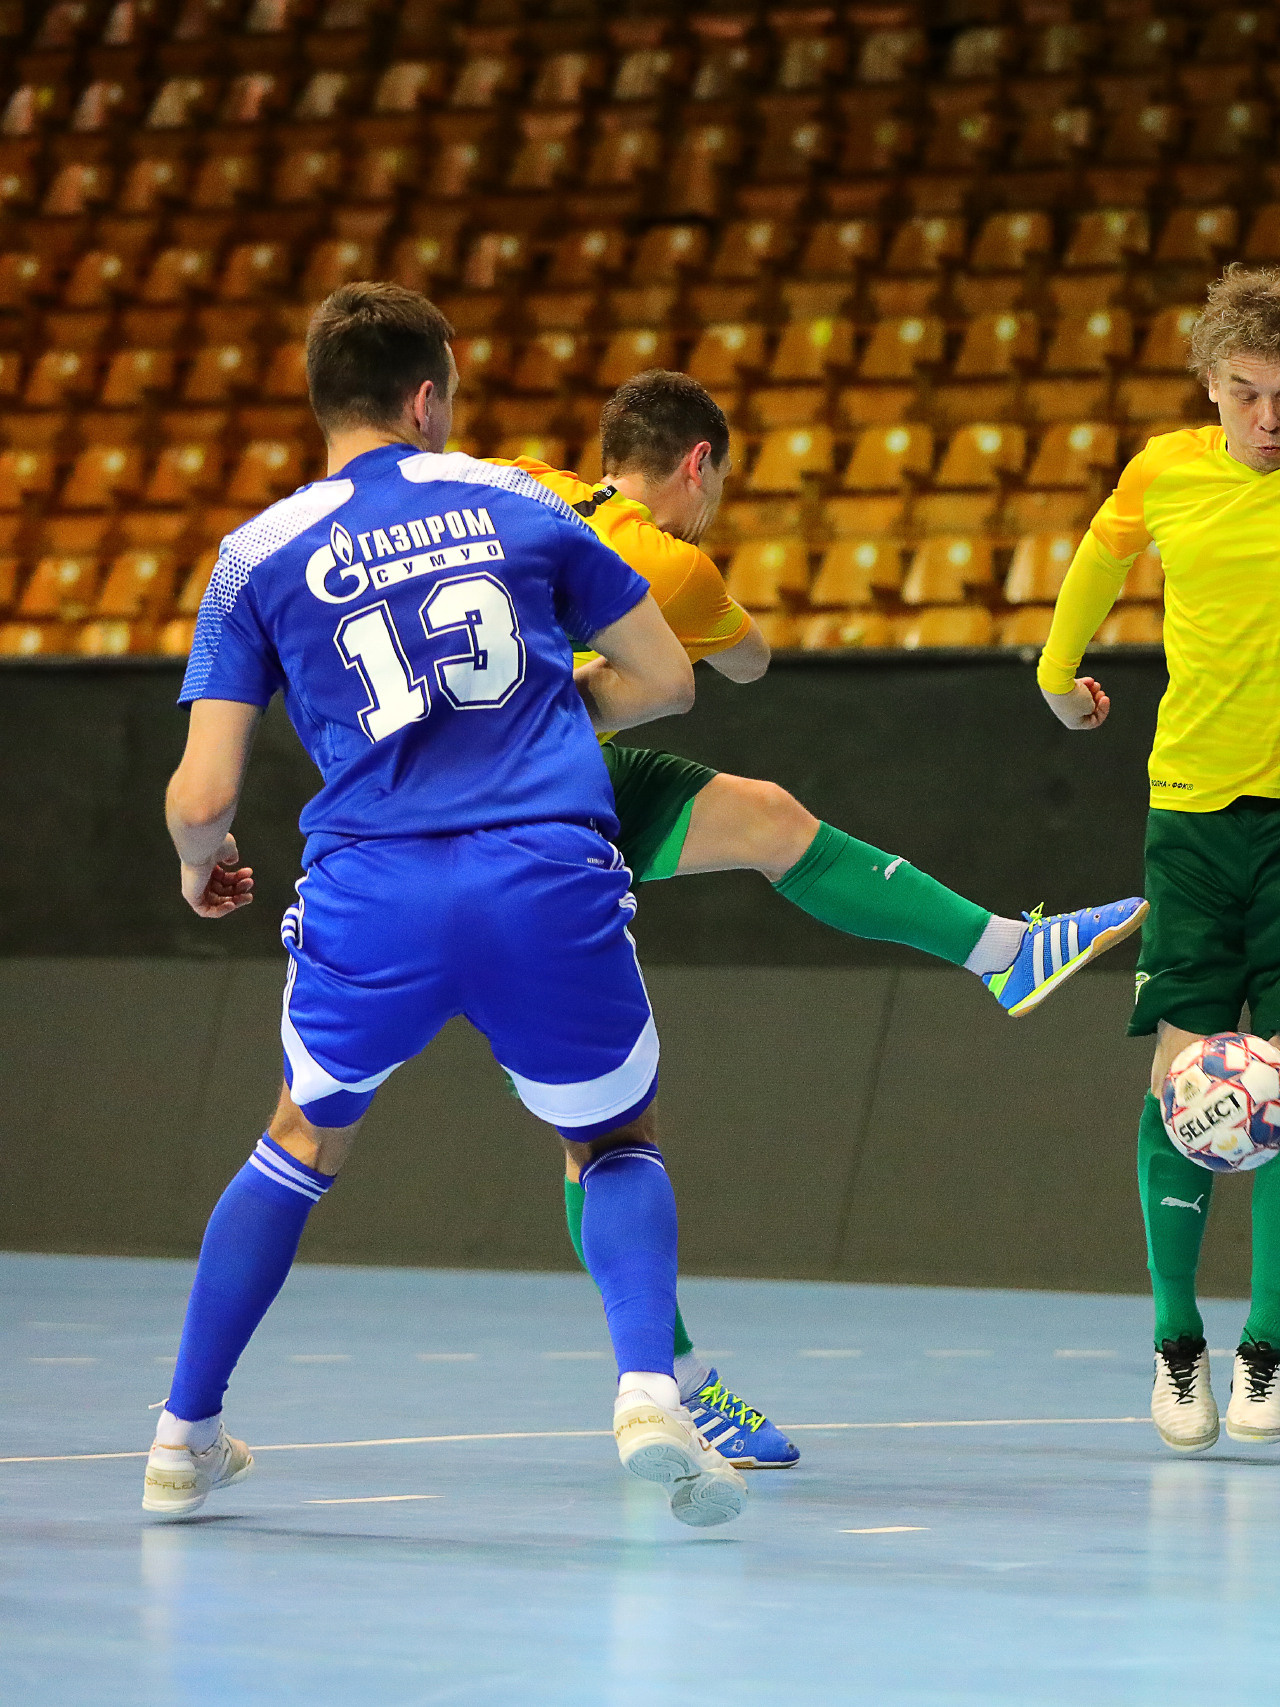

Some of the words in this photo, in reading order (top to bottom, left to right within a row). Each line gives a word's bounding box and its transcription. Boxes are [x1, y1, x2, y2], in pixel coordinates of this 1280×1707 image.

[356, 507, 497, 562] ГАЗПРОМ
[376, 543, 500, 584] СУМУО
[332, 570, 528, 745] 13
[1178, 1091, 1242, 1144] SELECT
